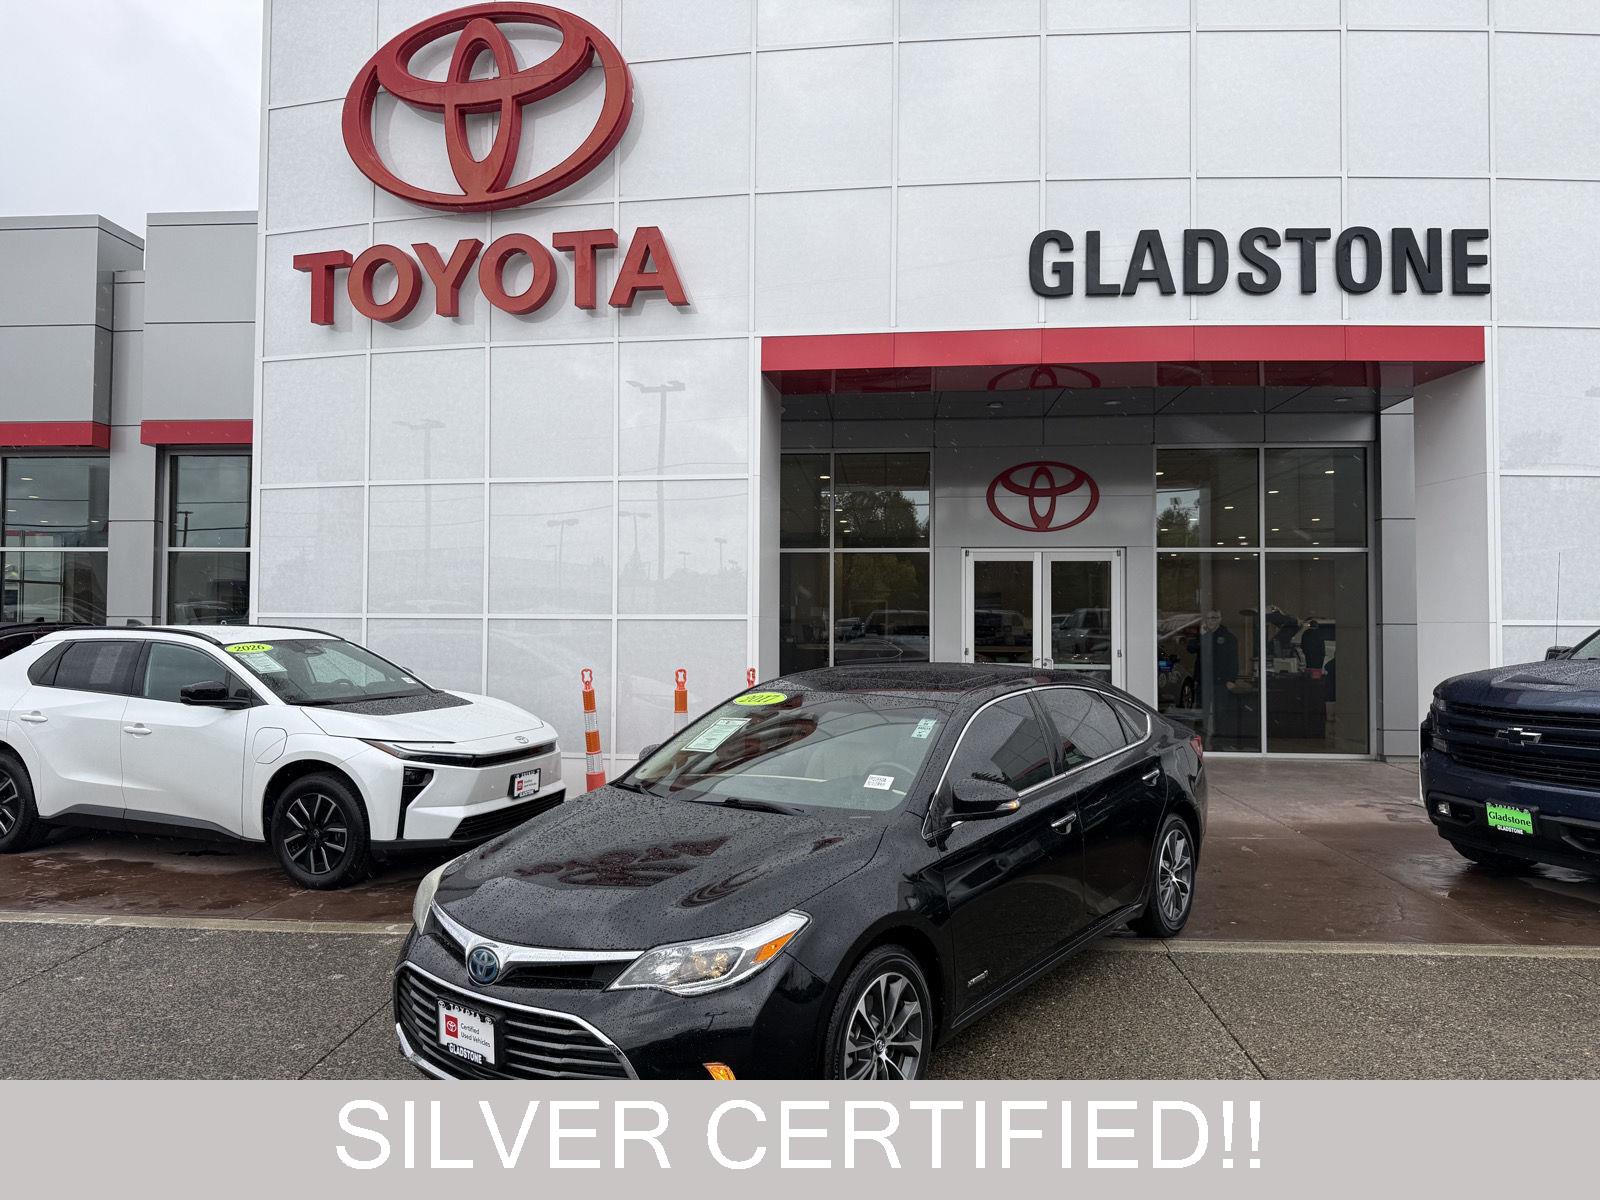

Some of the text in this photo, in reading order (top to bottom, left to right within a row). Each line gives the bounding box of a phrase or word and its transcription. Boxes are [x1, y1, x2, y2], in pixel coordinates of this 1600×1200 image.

[1028, 226, 1491, 297] GLADSTONE
[293, 225, 690, 326] TOYOTA
[1488, 811, 1532, 827] Gladstone
[1497, 824, 1524, 835] GLADSTONE
[449, 1003, 481, 1020] TOYOTA
[460, 1022, 480, 1035] Certified
[460, 1032, 491, 1048] Used Vehicles
[448, 1042, 483, 1064] GLADSTONE
